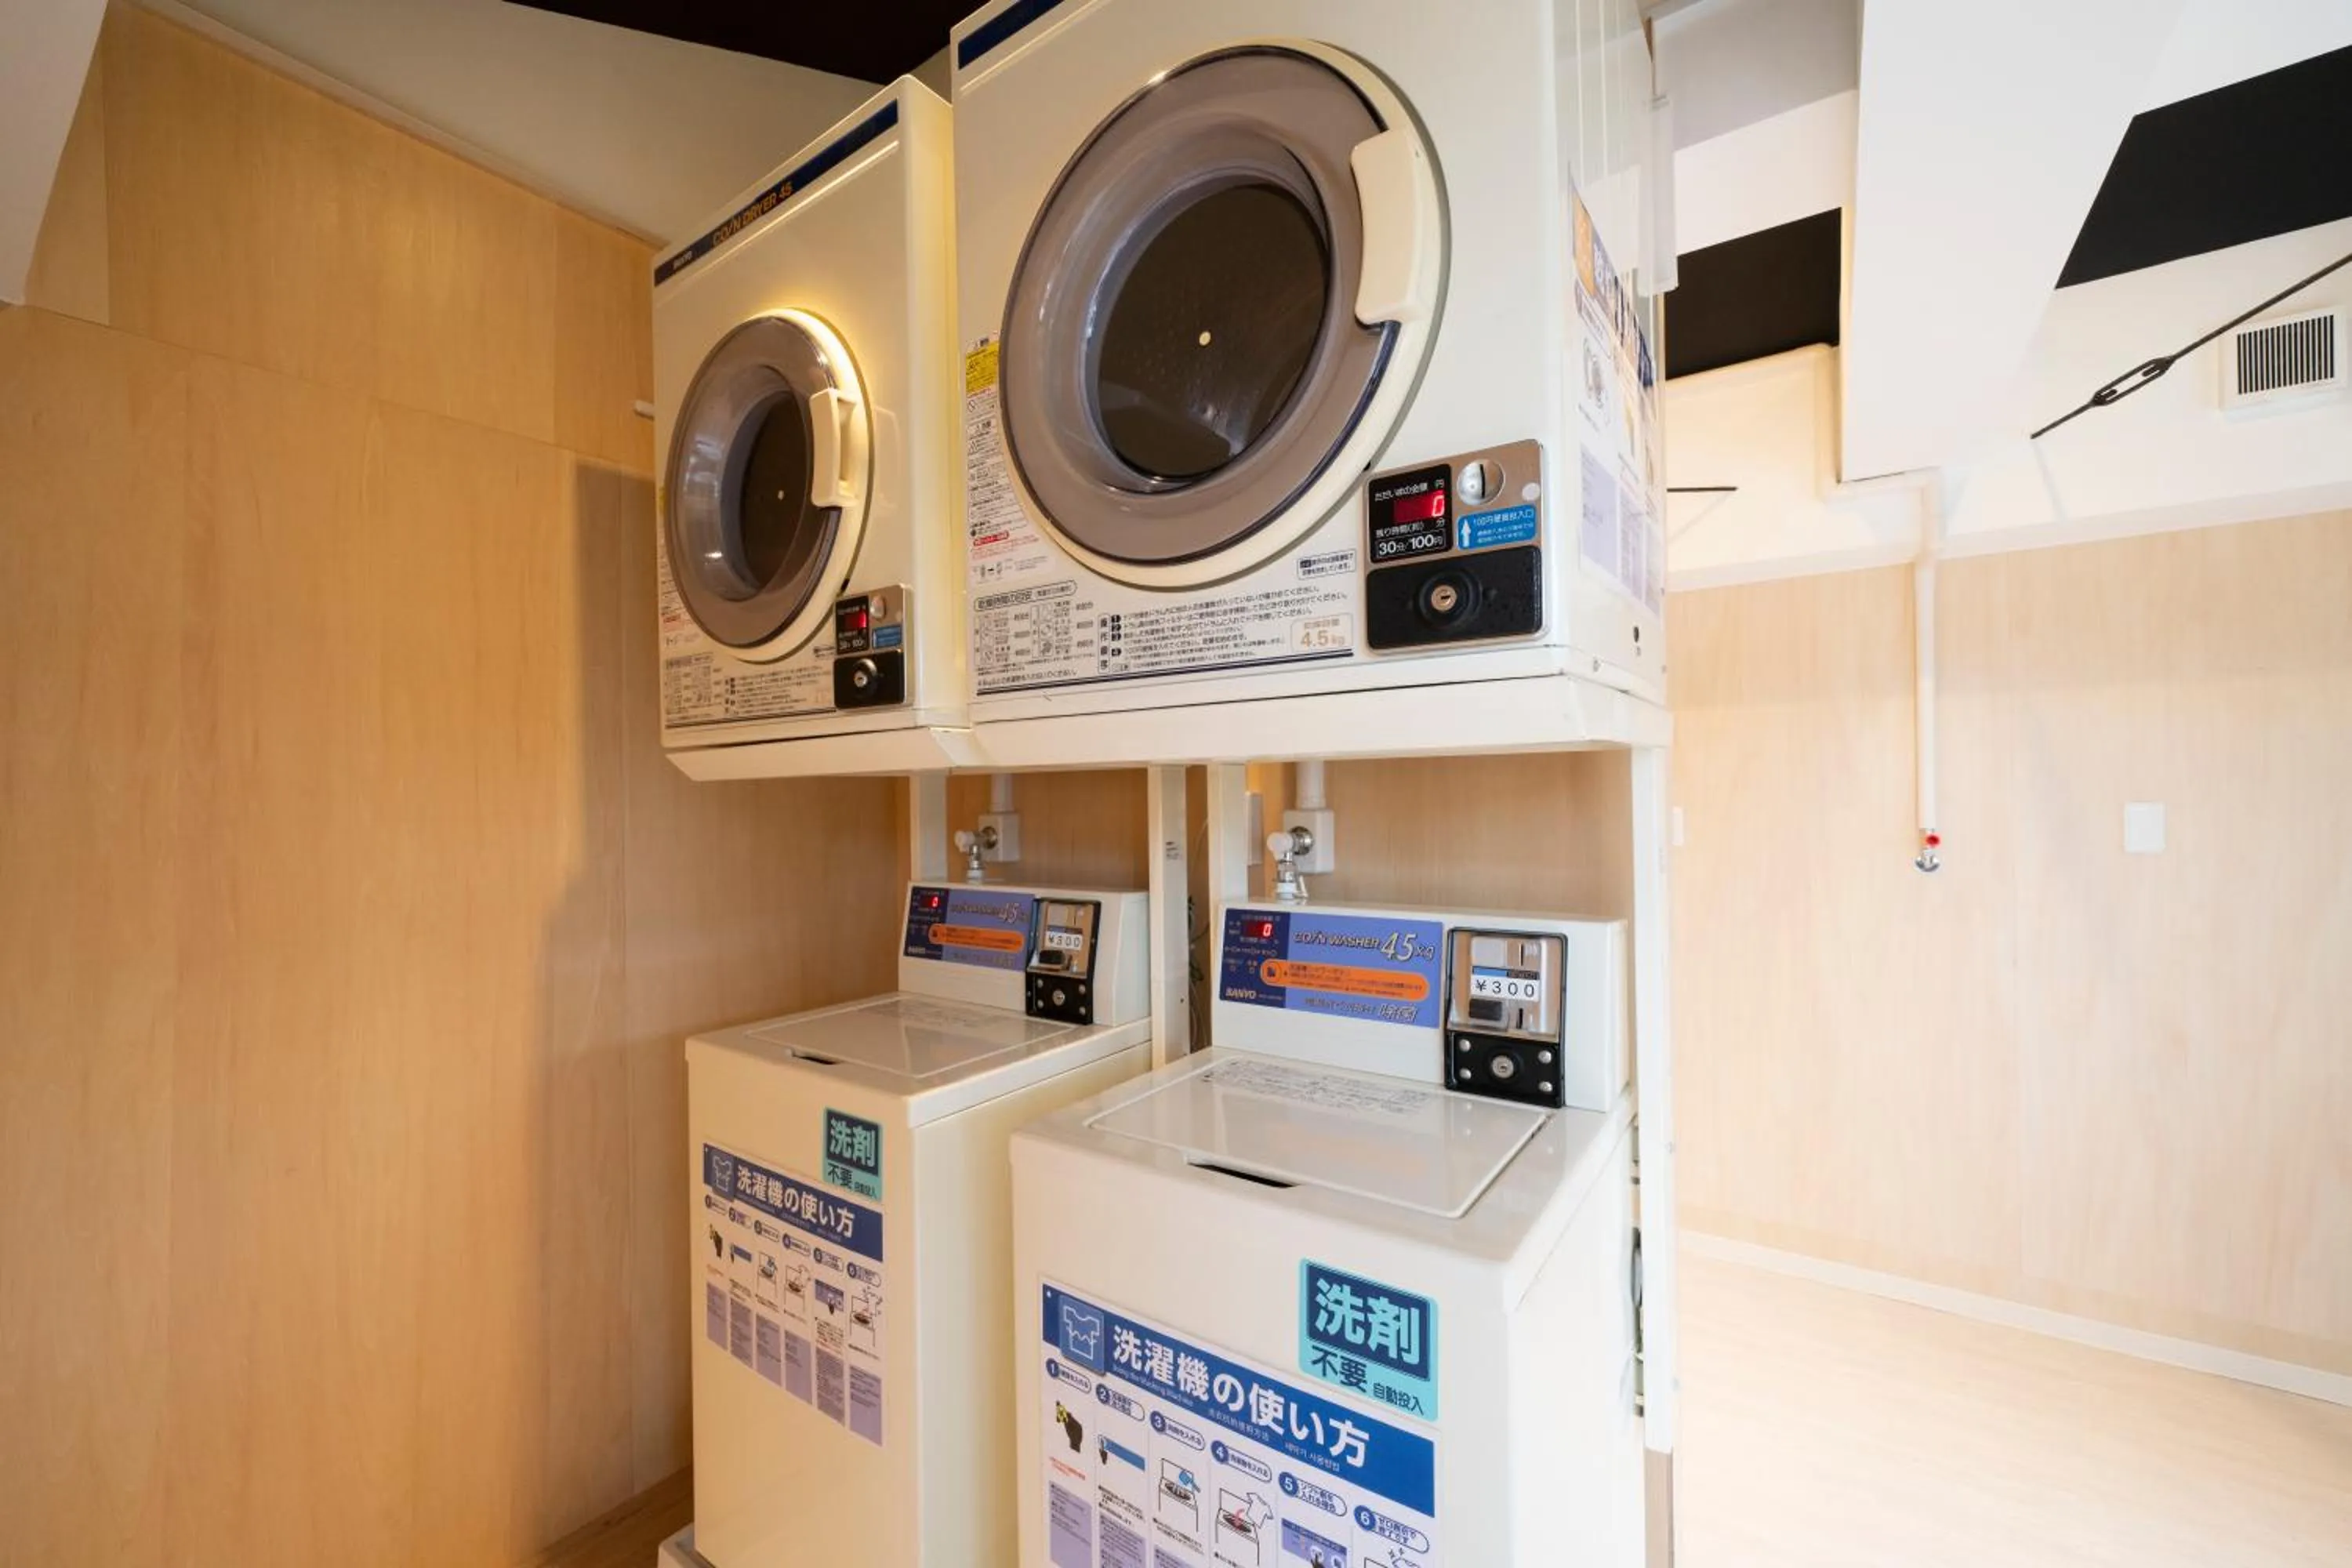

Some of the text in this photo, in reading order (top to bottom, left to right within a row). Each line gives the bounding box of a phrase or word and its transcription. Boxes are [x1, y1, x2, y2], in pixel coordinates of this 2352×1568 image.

[742, 193, 776, 226] DRYER
[1432, 495, 1445, 517] 0
[1263, 923, 1272, 937] 0
[1294, 931, 1327, 946] COIN
[1329, 935, 1380, 949] WASHER
[1225, 988, 1257, 1000] SANYO
[1475, 979, 1534, 997] ¥300
[829, 1117, 876, 1167] 洗剤
[828, 1163, 852, 1189] 不要
[737, 1165, 855, 1238] 洗濯機の使い方
[1316, 1278, 1420, 1364] 洗剤
[1311, 1345, 1425, 1416] 不要 自動投入
[1112, 1324, 1370, 1468] 洗濯機の使い方
